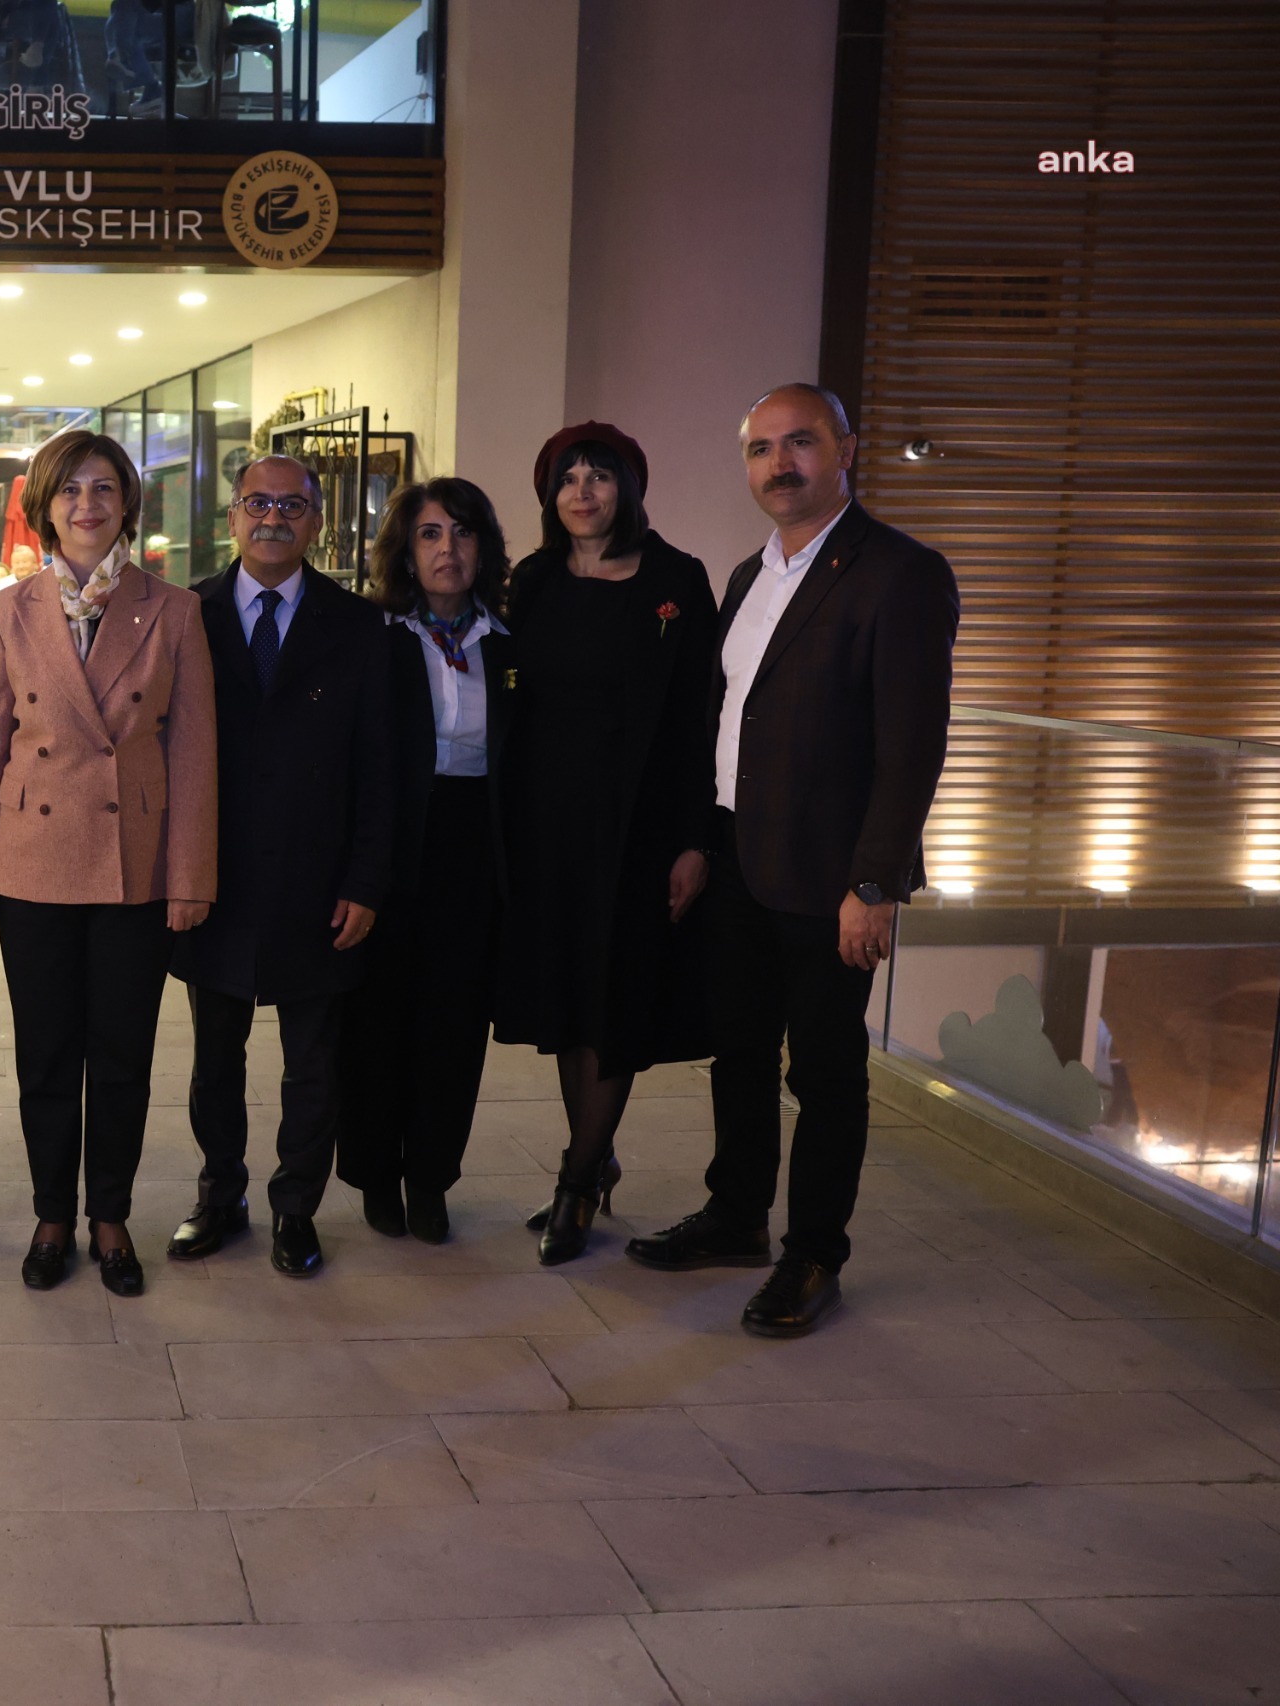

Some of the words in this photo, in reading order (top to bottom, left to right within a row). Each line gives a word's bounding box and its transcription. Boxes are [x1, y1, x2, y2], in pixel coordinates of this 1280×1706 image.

[246, 159, 314, 182] ESKİŞEHİR
[231, 193, 283, 261] BÜYÜKŞEHİR
[289, 194, 331, 260] BELEDİYESİ
